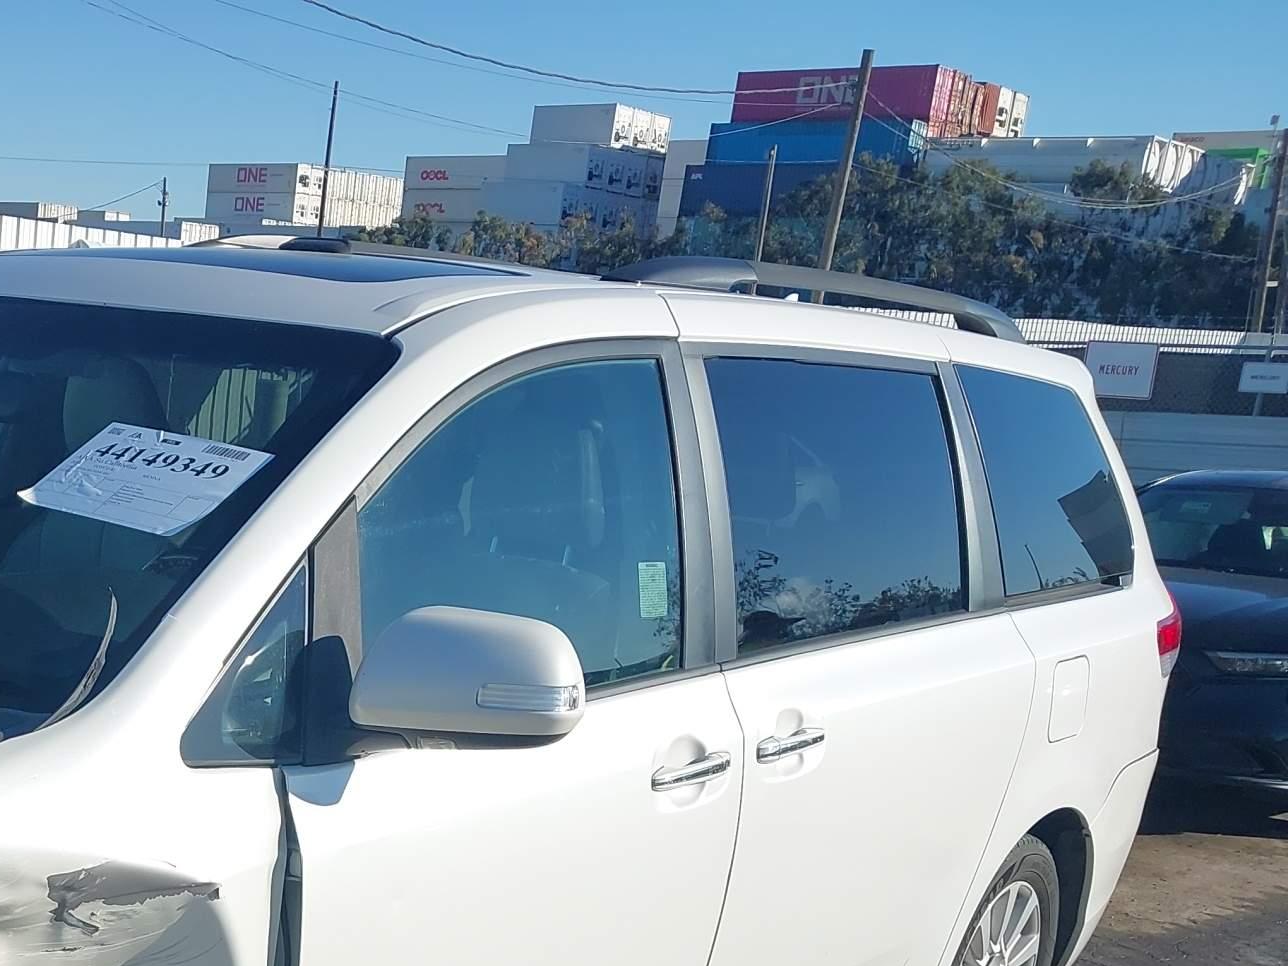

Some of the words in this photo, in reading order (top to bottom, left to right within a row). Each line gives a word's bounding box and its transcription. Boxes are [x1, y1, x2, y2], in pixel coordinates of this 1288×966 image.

[236, 167, 268, 183] ONE
[233, 196, 265, 212] ONE
[1098, 363, 1140, 377] MERCURY
[95, 442, 230, 480] 44149349
